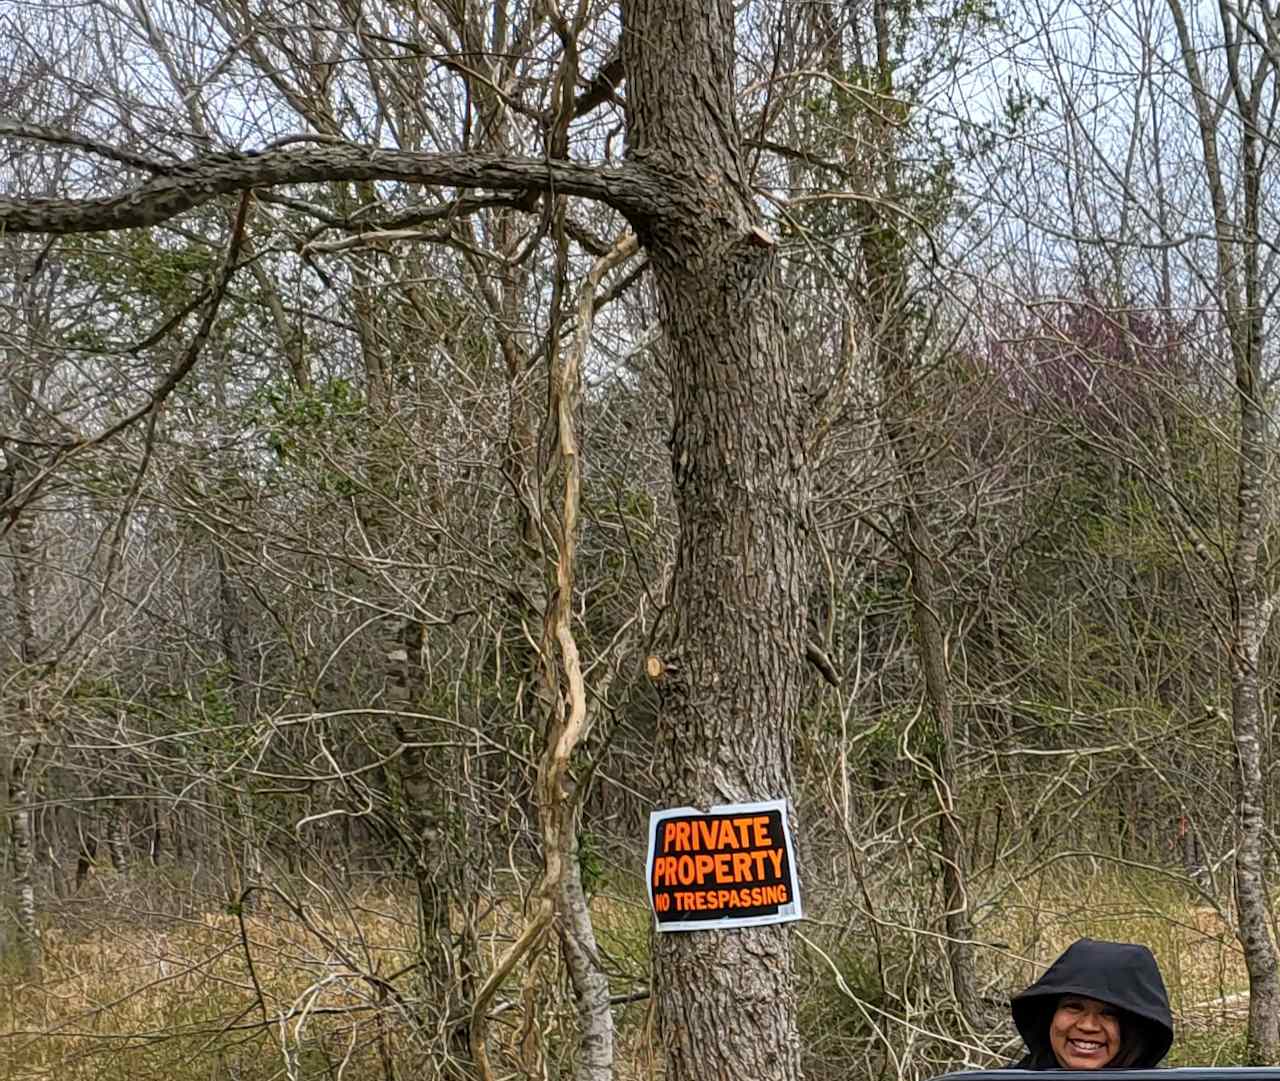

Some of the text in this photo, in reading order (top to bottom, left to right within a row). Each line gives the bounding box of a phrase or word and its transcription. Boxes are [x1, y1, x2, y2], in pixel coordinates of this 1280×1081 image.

[664, 816, 772, 852] PRIVATE
[654, 848, 784, 887] PROPERTY
[655, 885, 787, 912] NO TRESPASSING
